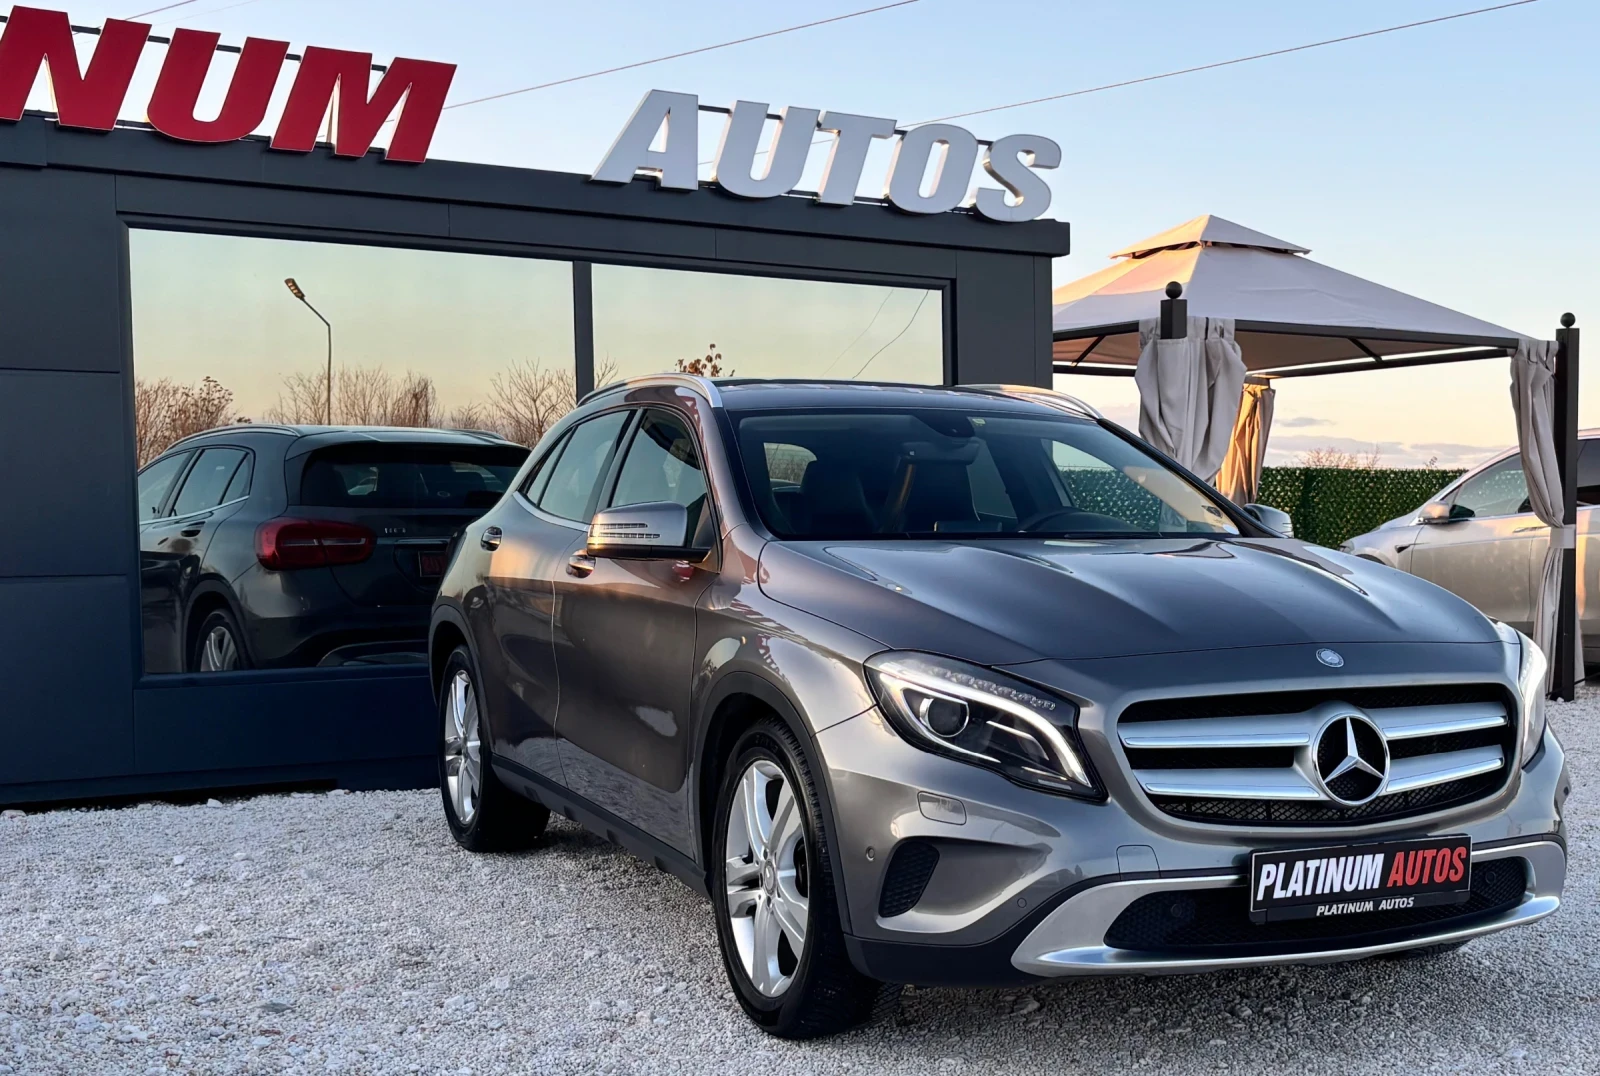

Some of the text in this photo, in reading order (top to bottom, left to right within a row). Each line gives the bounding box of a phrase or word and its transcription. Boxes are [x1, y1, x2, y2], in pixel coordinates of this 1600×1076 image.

[0, 5, 1062, 223] NUM AUTOS
[1257, 847, 1466, 901] PLATINUM AUTOS
[1316, 897, 1414, 916] PLATINUM AUTOS
